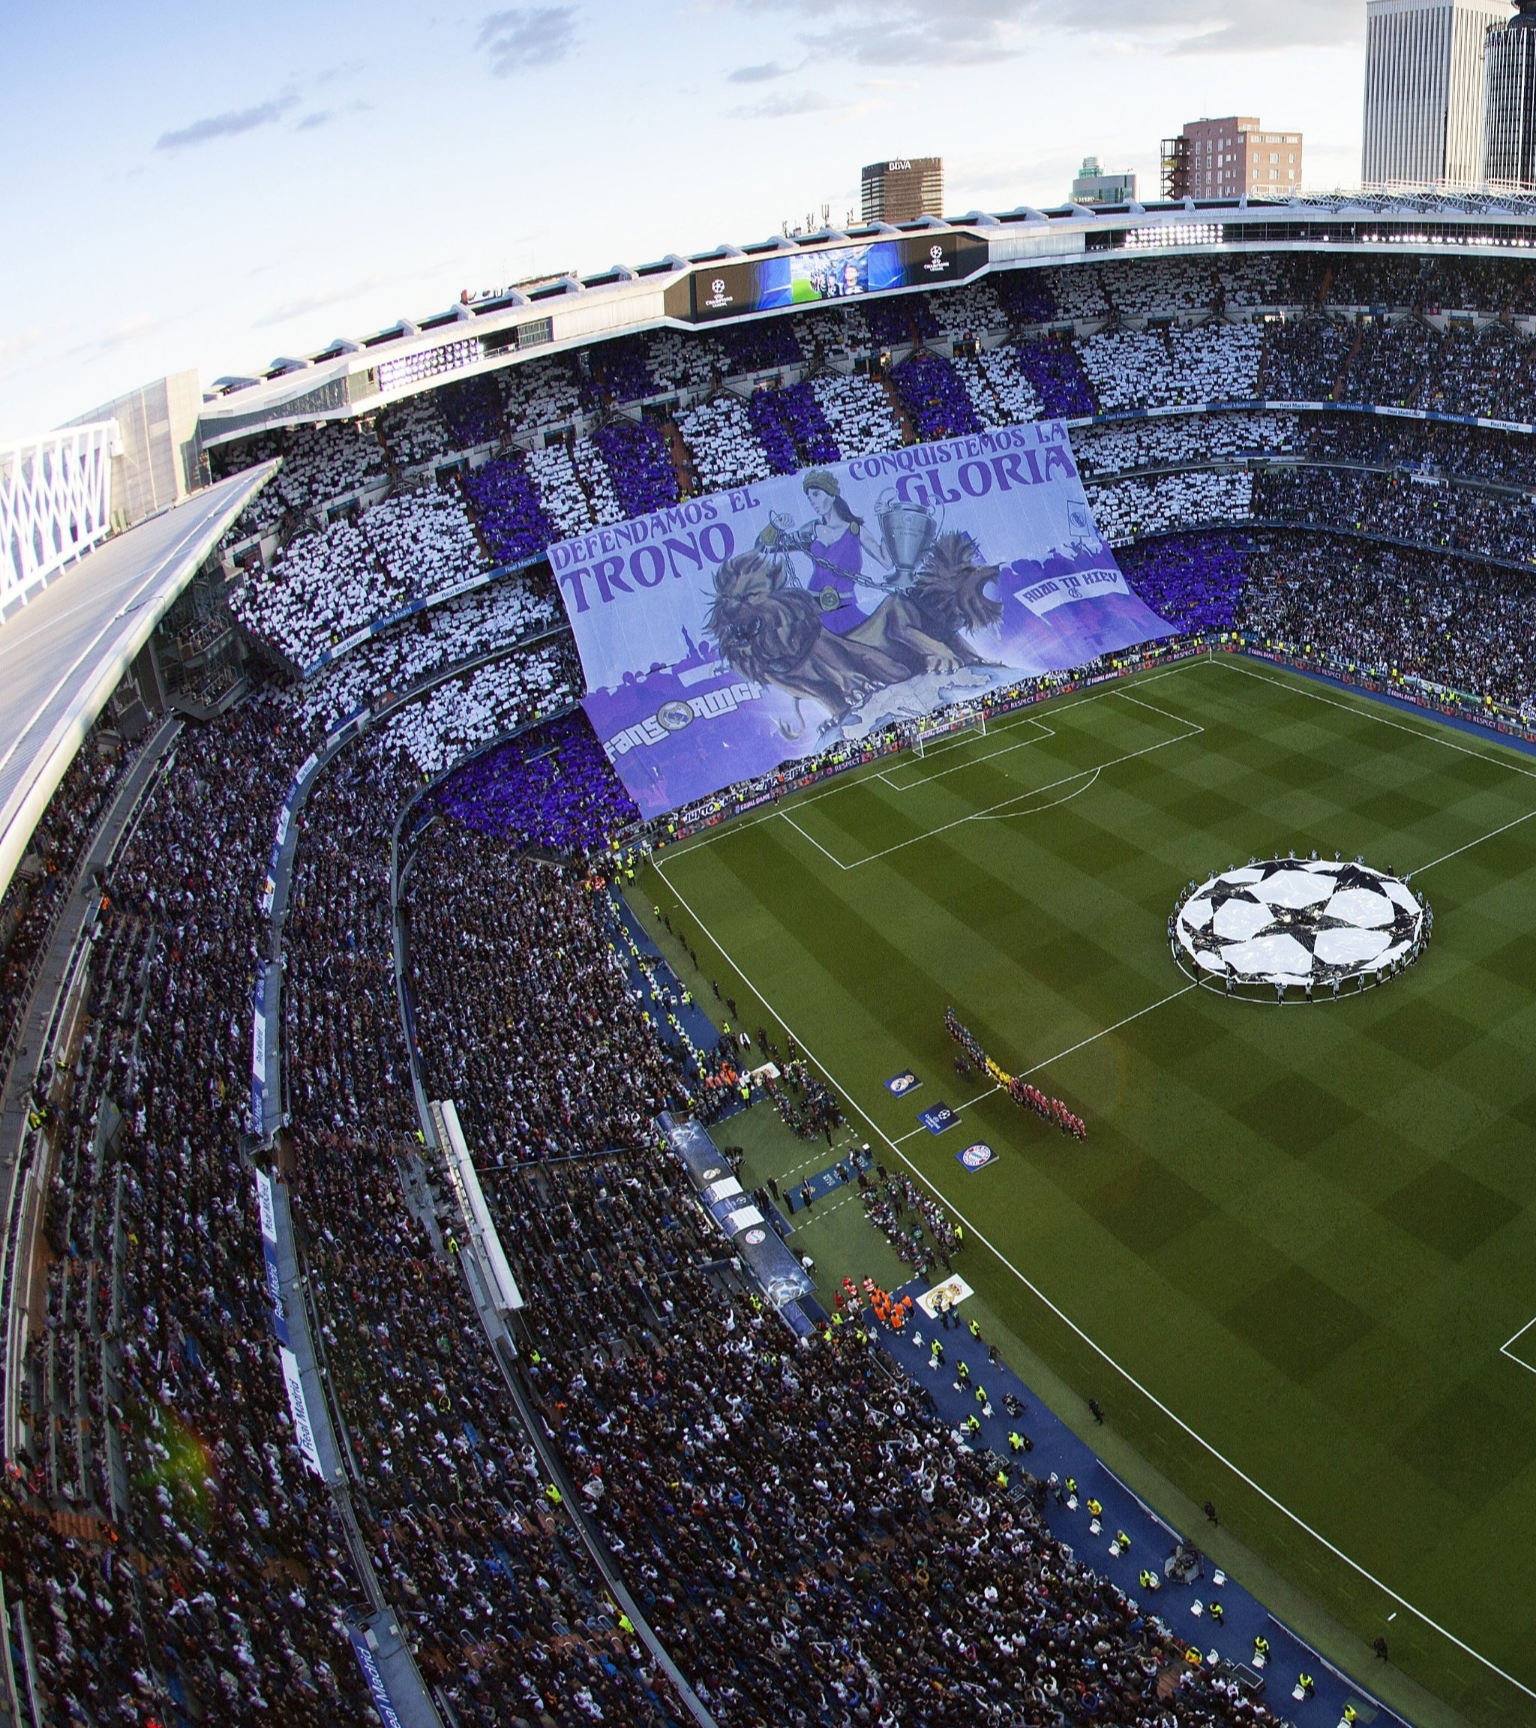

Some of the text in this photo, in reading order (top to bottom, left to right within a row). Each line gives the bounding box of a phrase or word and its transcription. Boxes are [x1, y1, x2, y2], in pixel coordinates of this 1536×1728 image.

[889, 160, 911, 171] BBVA
[849, 422, 1067, 481] CONQUISTEMOS LA
[896, 445, 1077, 508] GLORIA
[550, 488, 761, 571] DEFENDAMOS EL
[441, 581, 475, 599] Real Madrid
[559, 522, 735, 613] TRONO
[1022, 571, 1118, 603] ROAD TO KIEV
[1472, 715, 1496, 728] RESPECT
[834, 756, 860, 773] RESPECT
[260, 1181, 274, 1235] Real Madrid
[268, 1260, 285, 1322] Real Madrid
[288, 1378, 316, 1453] Real Madrid
[356, 1646, 402, 1728] eal Madrid
